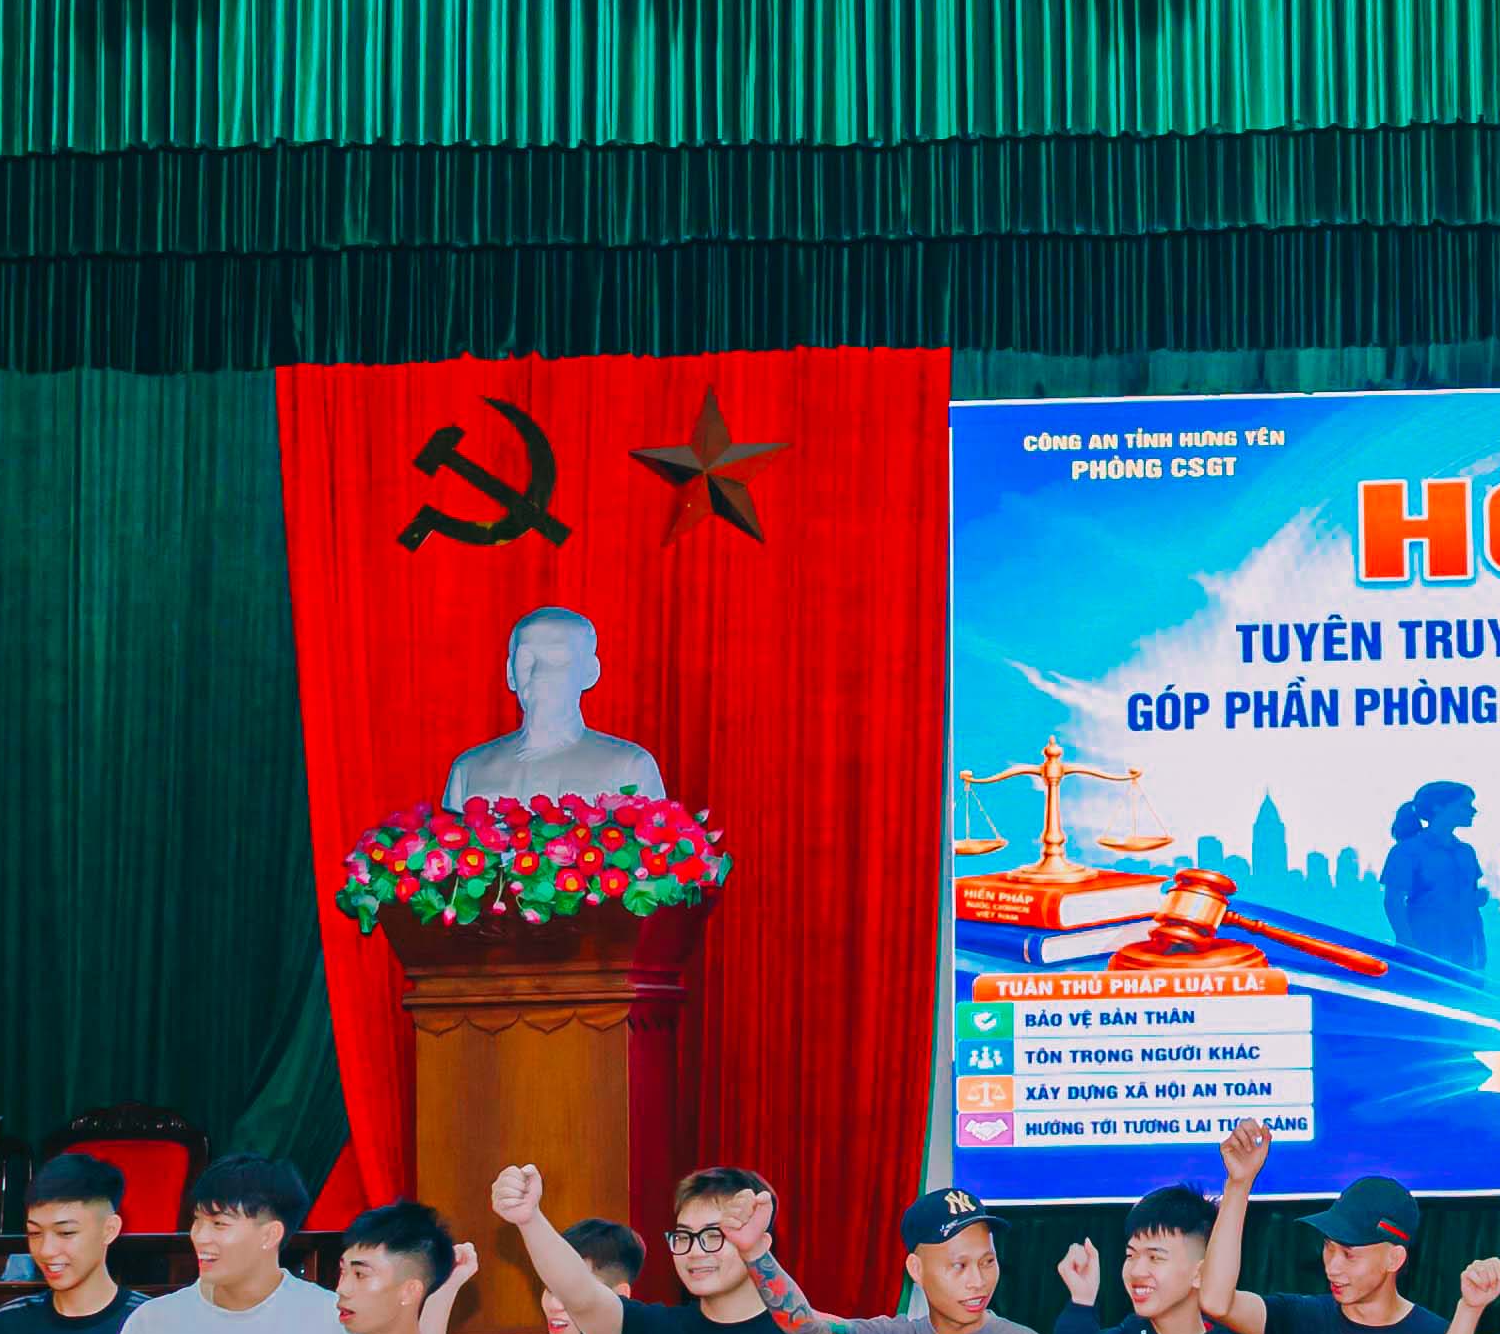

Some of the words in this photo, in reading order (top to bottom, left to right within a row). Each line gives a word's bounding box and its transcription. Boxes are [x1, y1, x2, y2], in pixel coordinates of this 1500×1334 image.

[1024, 433, 1082, 451] CÔNG
[1089, 433, 1118, 449] AN
[1125, 427, 1172, 448] TỈNH
[1180, 431, 1237, 447] HƯNG
[1245, 427, 1285, 446] YÊN
[1072, 455, 1162, 480] PHÒNG
[1171, 457, 1236, 477] CSGT
[1236, 614, 1383, 664] TUYÊN
[1127, 684, 1209, 732] GÓP
[1226, 676, 1341, 730] PHẦN
[1355, 678, 1498, 728] PHÒNG
[996, 980, 1052, 997] TUÂN
[1109, 978, 1166, 994] PHÁP
[1174, 976, 1226, 996] LUẬT
[1025, 1011, 1062, 1028] BẢO
[1069, 1009, 1093, 1028] VỆ
[1144, 1010, 1195, 1025] THÂN
[1025, 1048, 1062, 1064] TÔN
[1069, 1050, 1133, 1065] TRỌNG
[1141, 1045, 1201, 1062] NGƯỜI
[1209, 1044, 1261, 1060] KHÁC
[1026, 1085, 1060, 1101] XÂY
[1068, 1083, 1117, 1101] DỰNG
[1155, 1082, 1185, 1100] HỘI
[1193, 1083, 1217, 1097] AN
[1223, 1078, 1272, 1096] TOÀN
[1026, 1117, 1084, 1136] HƯỚNG
[1091, 1117, 1117, 1135] TỚI
[1123, 1119, 1179, 1134] TƯƠNG
[1186, 1118, 1212, 1132] LAI
